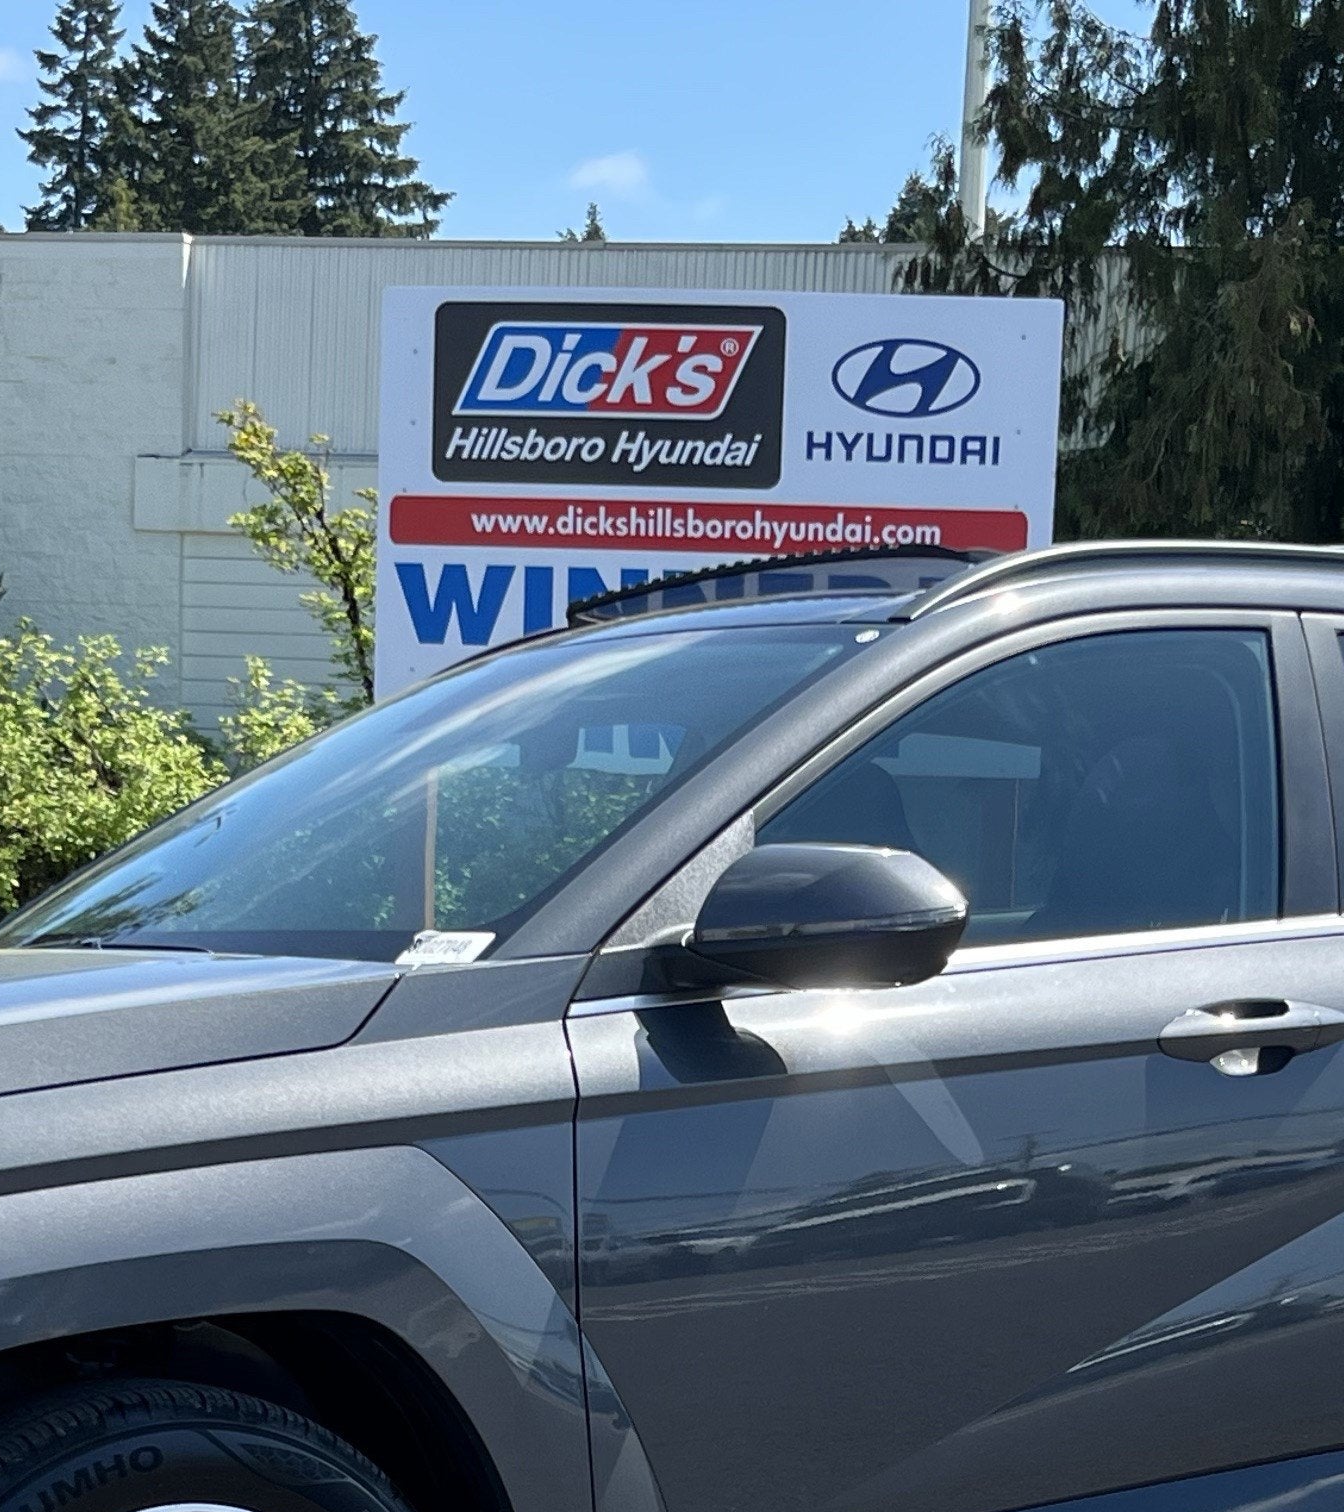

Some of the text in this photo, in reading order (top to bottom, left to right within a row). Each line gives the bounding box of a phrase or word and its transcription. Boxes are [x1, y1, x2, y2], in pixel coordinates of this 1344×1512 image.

[476, 333, 724, 407] Dick's
[445, 426, 763, 472] Hillsboro Hyundai
[805, 430, 1001, 466] HYUNDAI
[470, 504, 942, 547] www.dickshillsborohyundai.com
